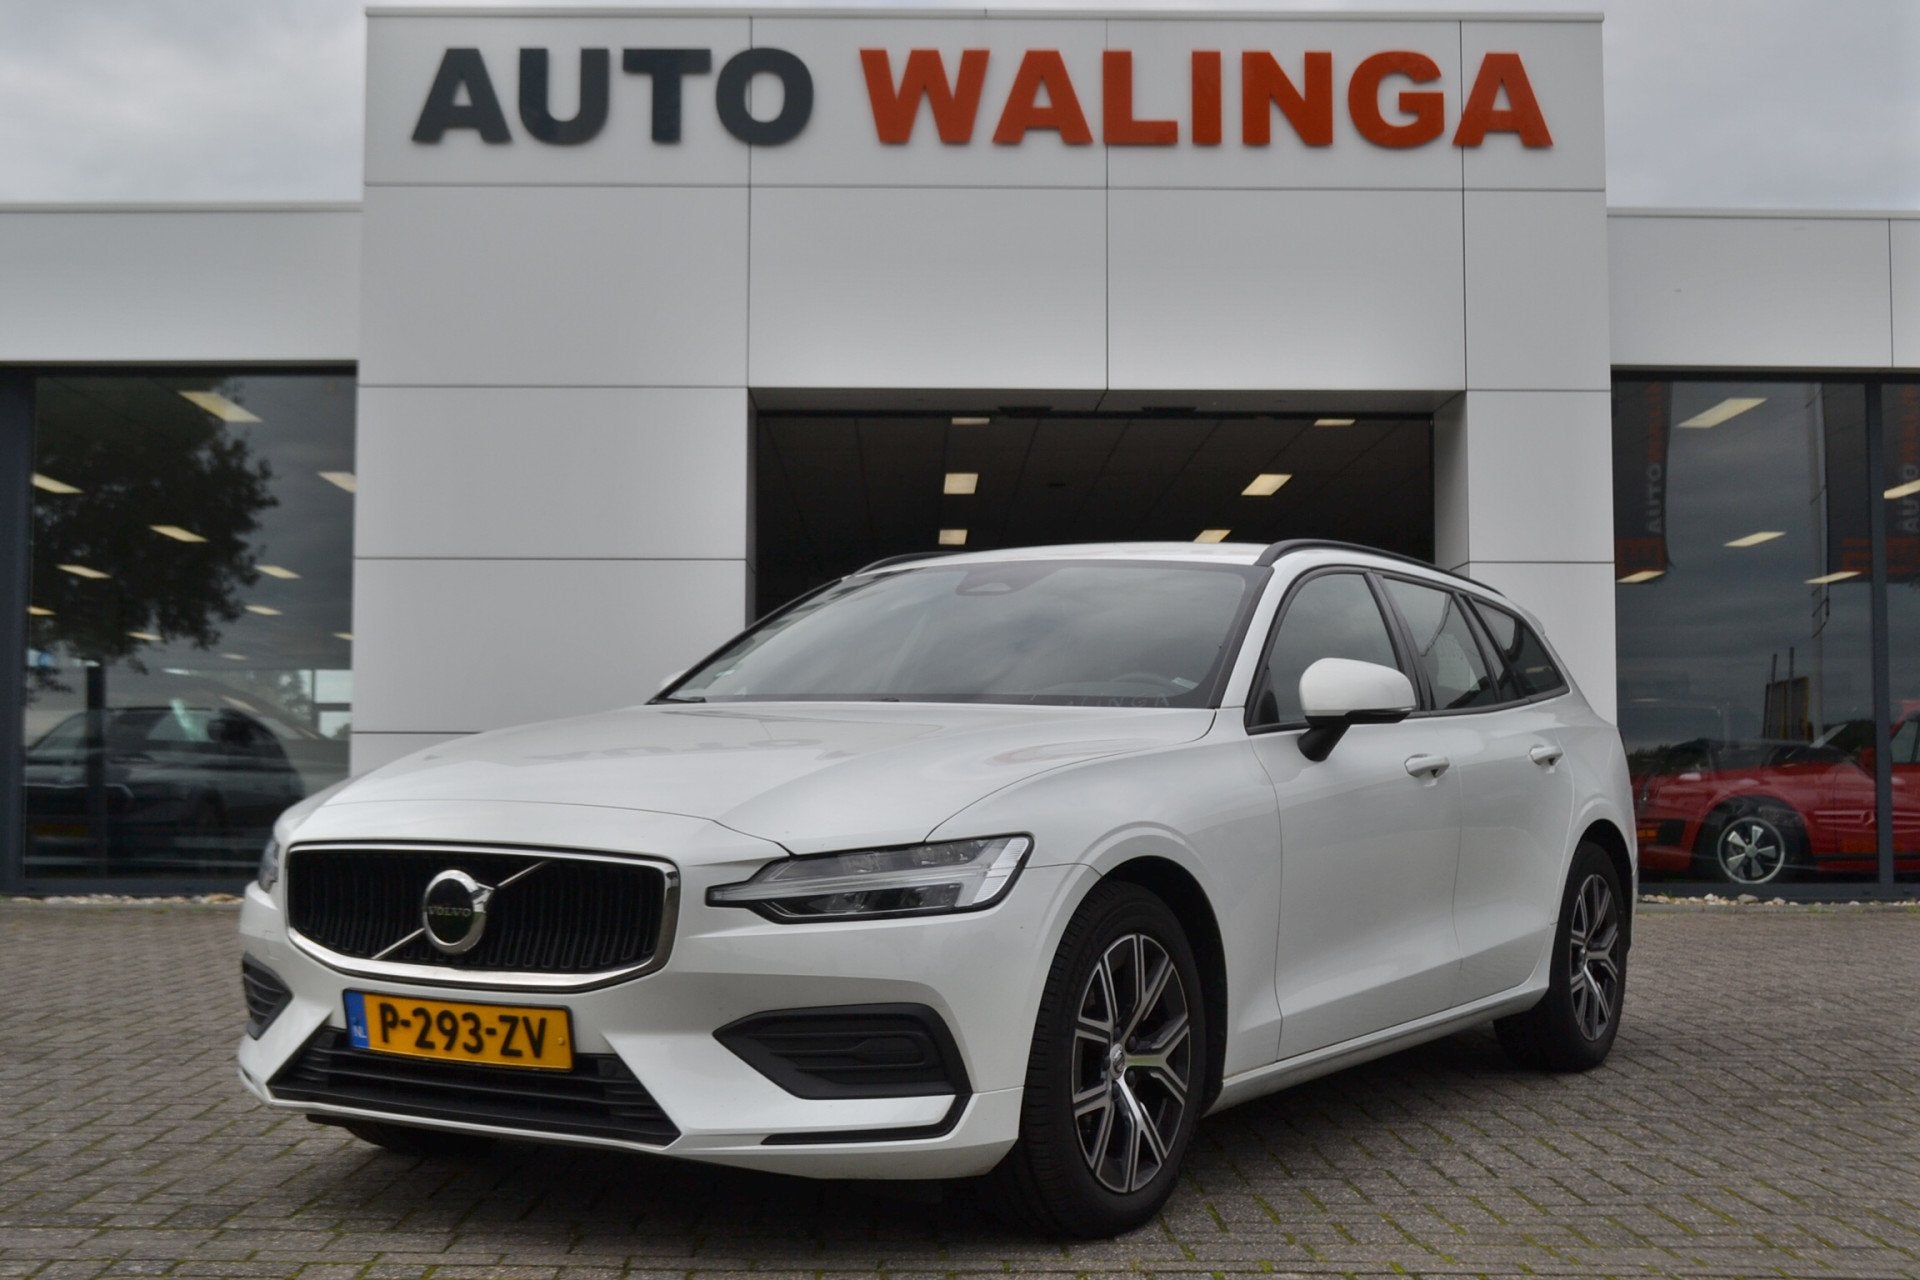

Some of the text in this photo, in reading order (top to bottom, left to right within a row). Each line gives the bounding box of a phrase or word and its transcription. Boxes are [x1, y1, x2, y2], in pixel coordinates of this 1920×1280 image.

[411, 47, 1554, 149] AUTO WALINGA
[1901, 463, 1919, 533] AUO
[428, 905, 472, 917] VOLVO
[352, 1002, 547, 1058] NL P-293-ZV
